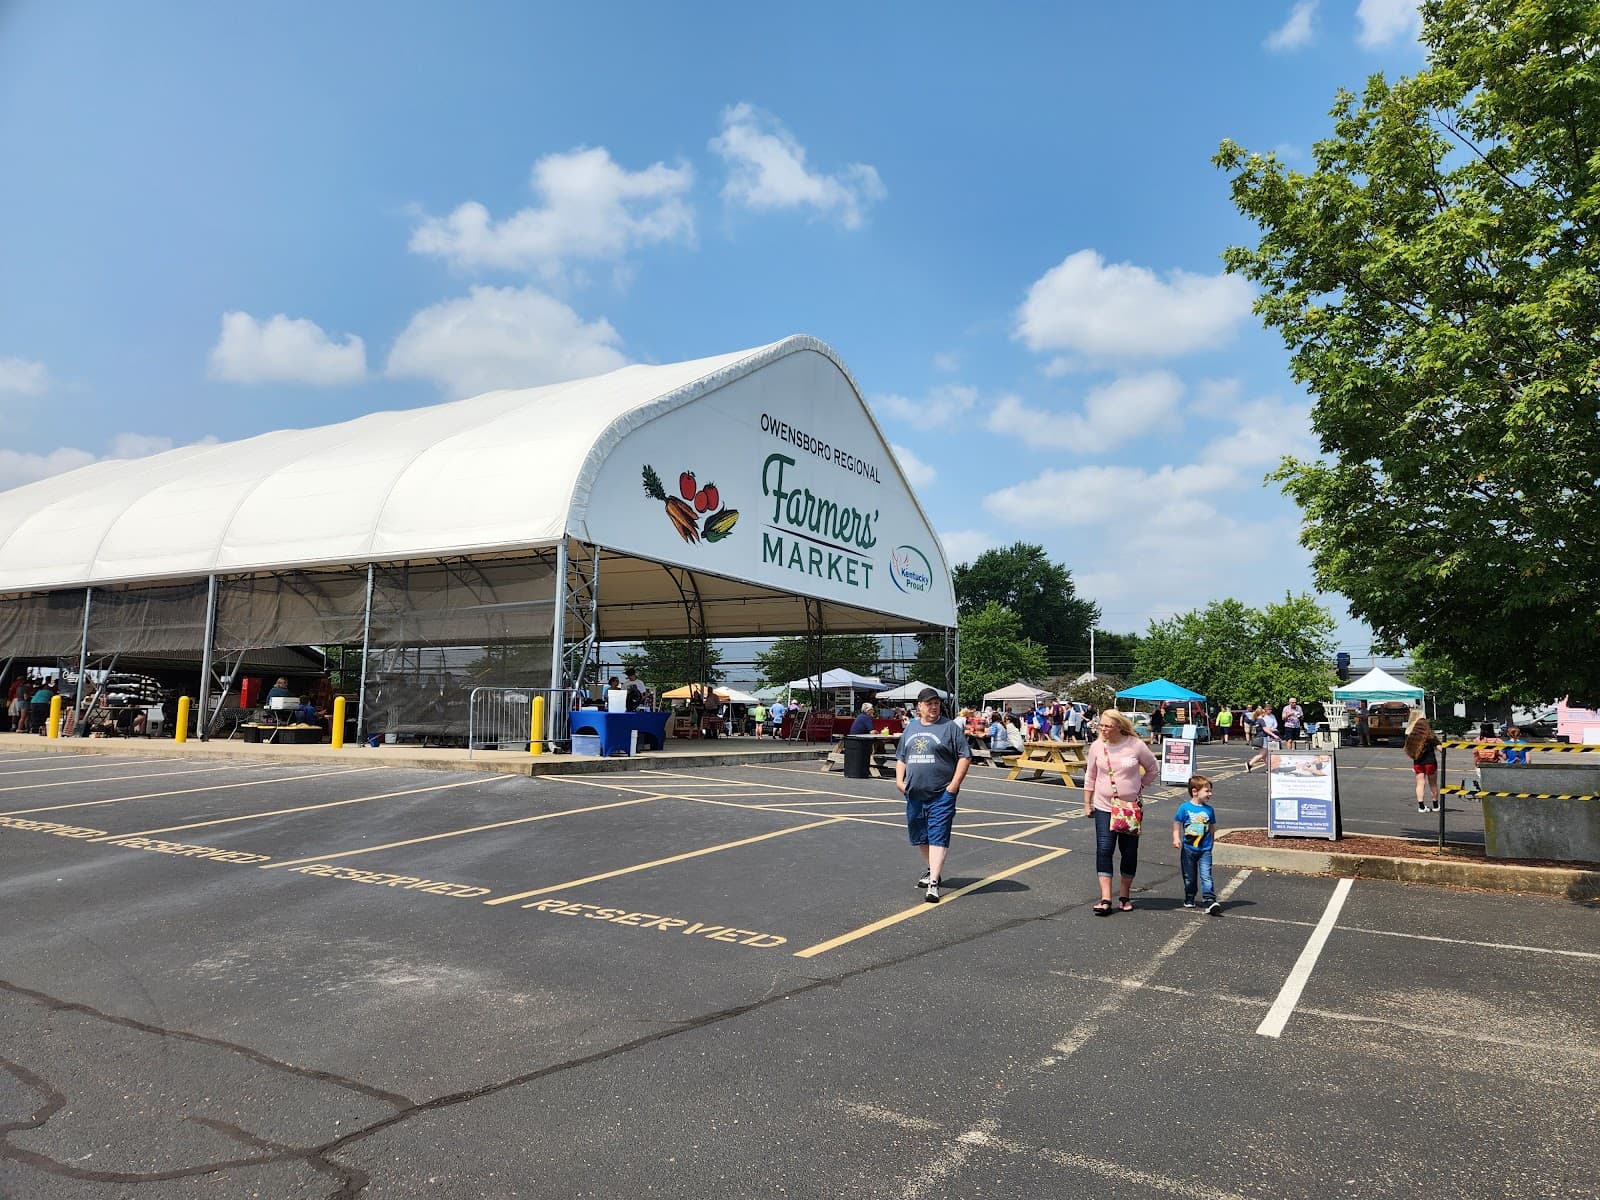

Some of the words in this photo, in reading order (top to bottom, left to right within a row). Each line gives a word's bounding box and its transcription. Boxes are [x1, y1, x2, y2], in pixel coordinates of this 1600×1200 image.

[760, 413, 831, 461] OWENSBORO
[834, 448, 880, 484] REGIONAL
[762, 453, 879, 549] Farmers'
[762, 532, 873, 589] MARKET
[901, 568, 929, 586] Kentucky
[906, 579, 924, 591] Proud
[107, 837, 271, 864] RESERVED
[288, 863, 492, 899] RESERVED
[521, 899, 788, 949] RESERVED
